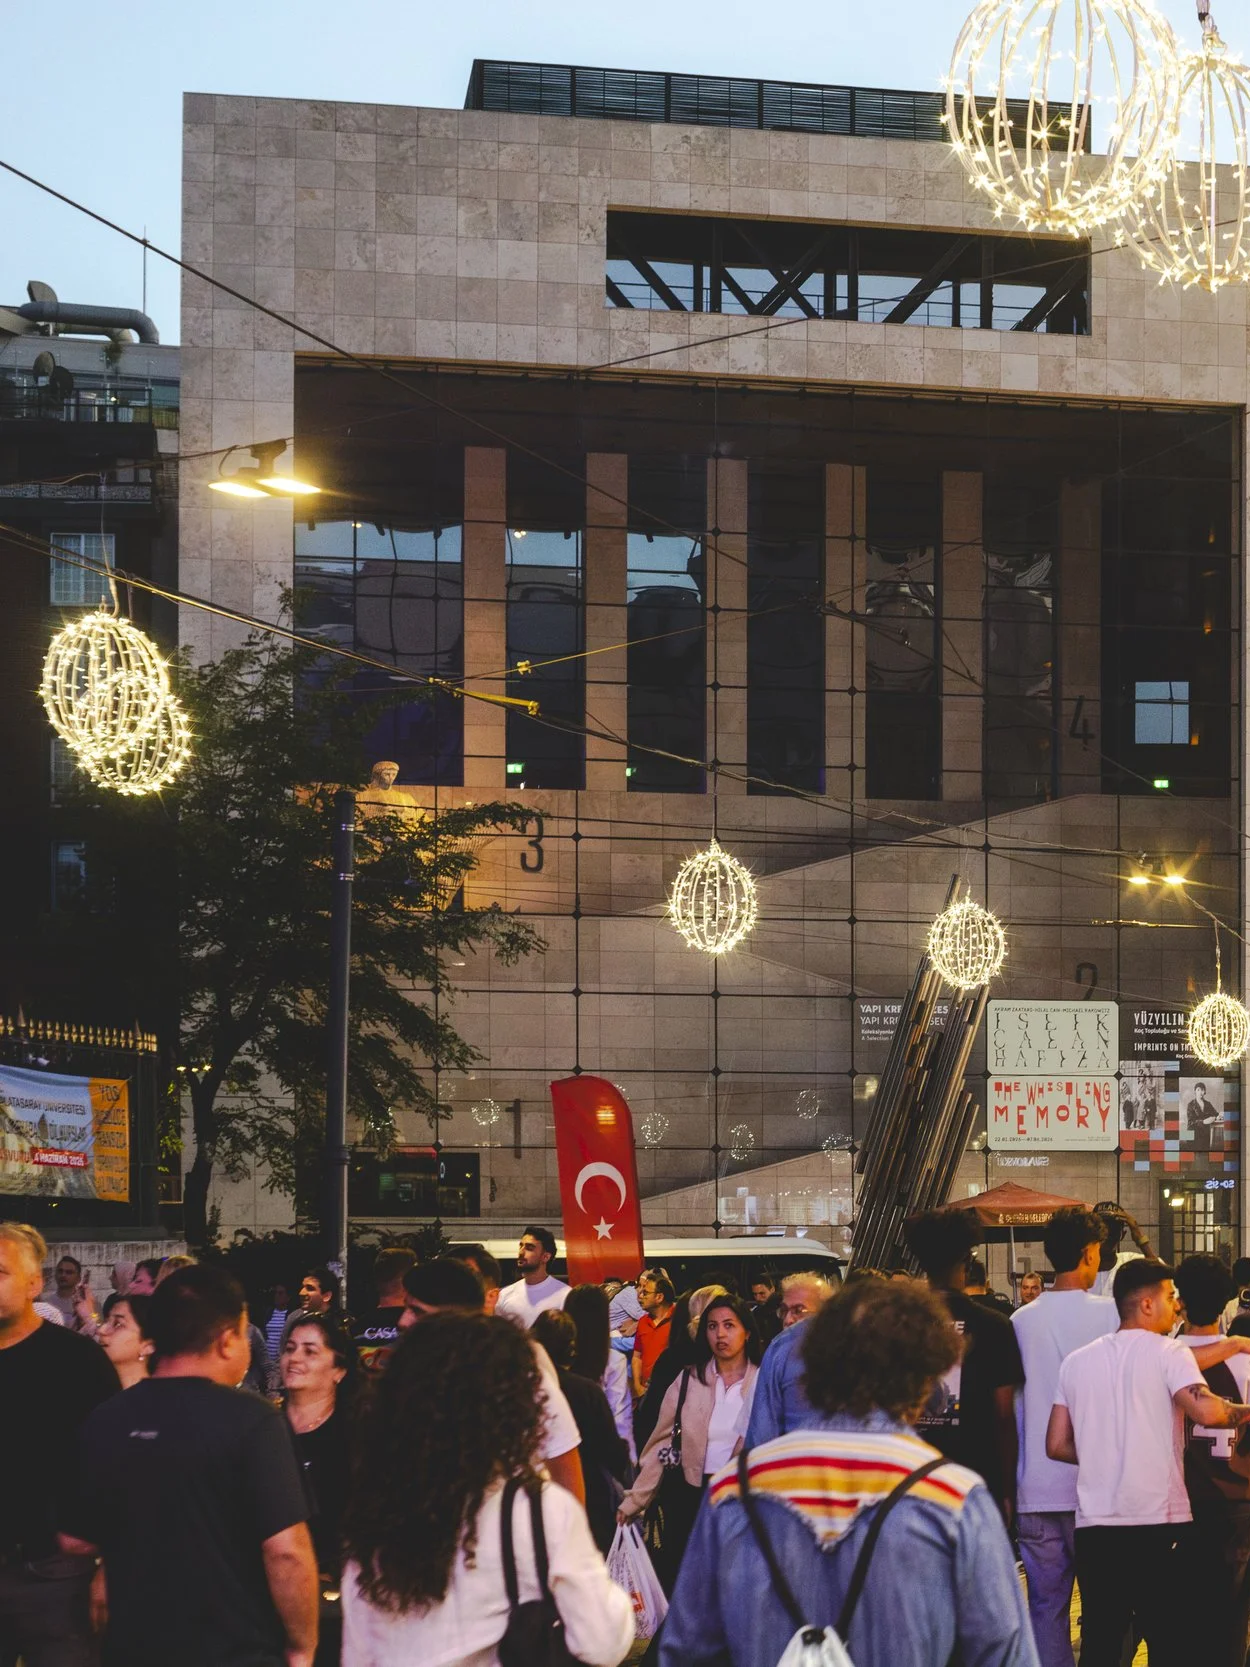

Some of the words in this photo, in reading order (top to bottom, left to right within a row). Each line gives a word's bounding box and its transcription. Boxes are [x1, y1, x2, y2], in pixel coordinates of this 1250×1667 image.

[1069, 695, 1096, 751] 4
[520, 814, 544, 873] 3
[860, 1005, 881, 1013] YAPI
[885, 1005, 902, 1014] KRE
[860, 1017, 880, 1025] YAPI
[1134, 1010, 1185, 1026] YÜZYILIN
[1134, 1042, 1168, 1052] IMPRINTS
[1169, 1042, 1179, 1052] ON
[994, 1081, 1021, 1102] THE
[1026, 1081, 1111, 1107] WHISTLING
[505, 1098, 522, 1159] 1
[994, 1104, 1111, 1135] MEMORY
